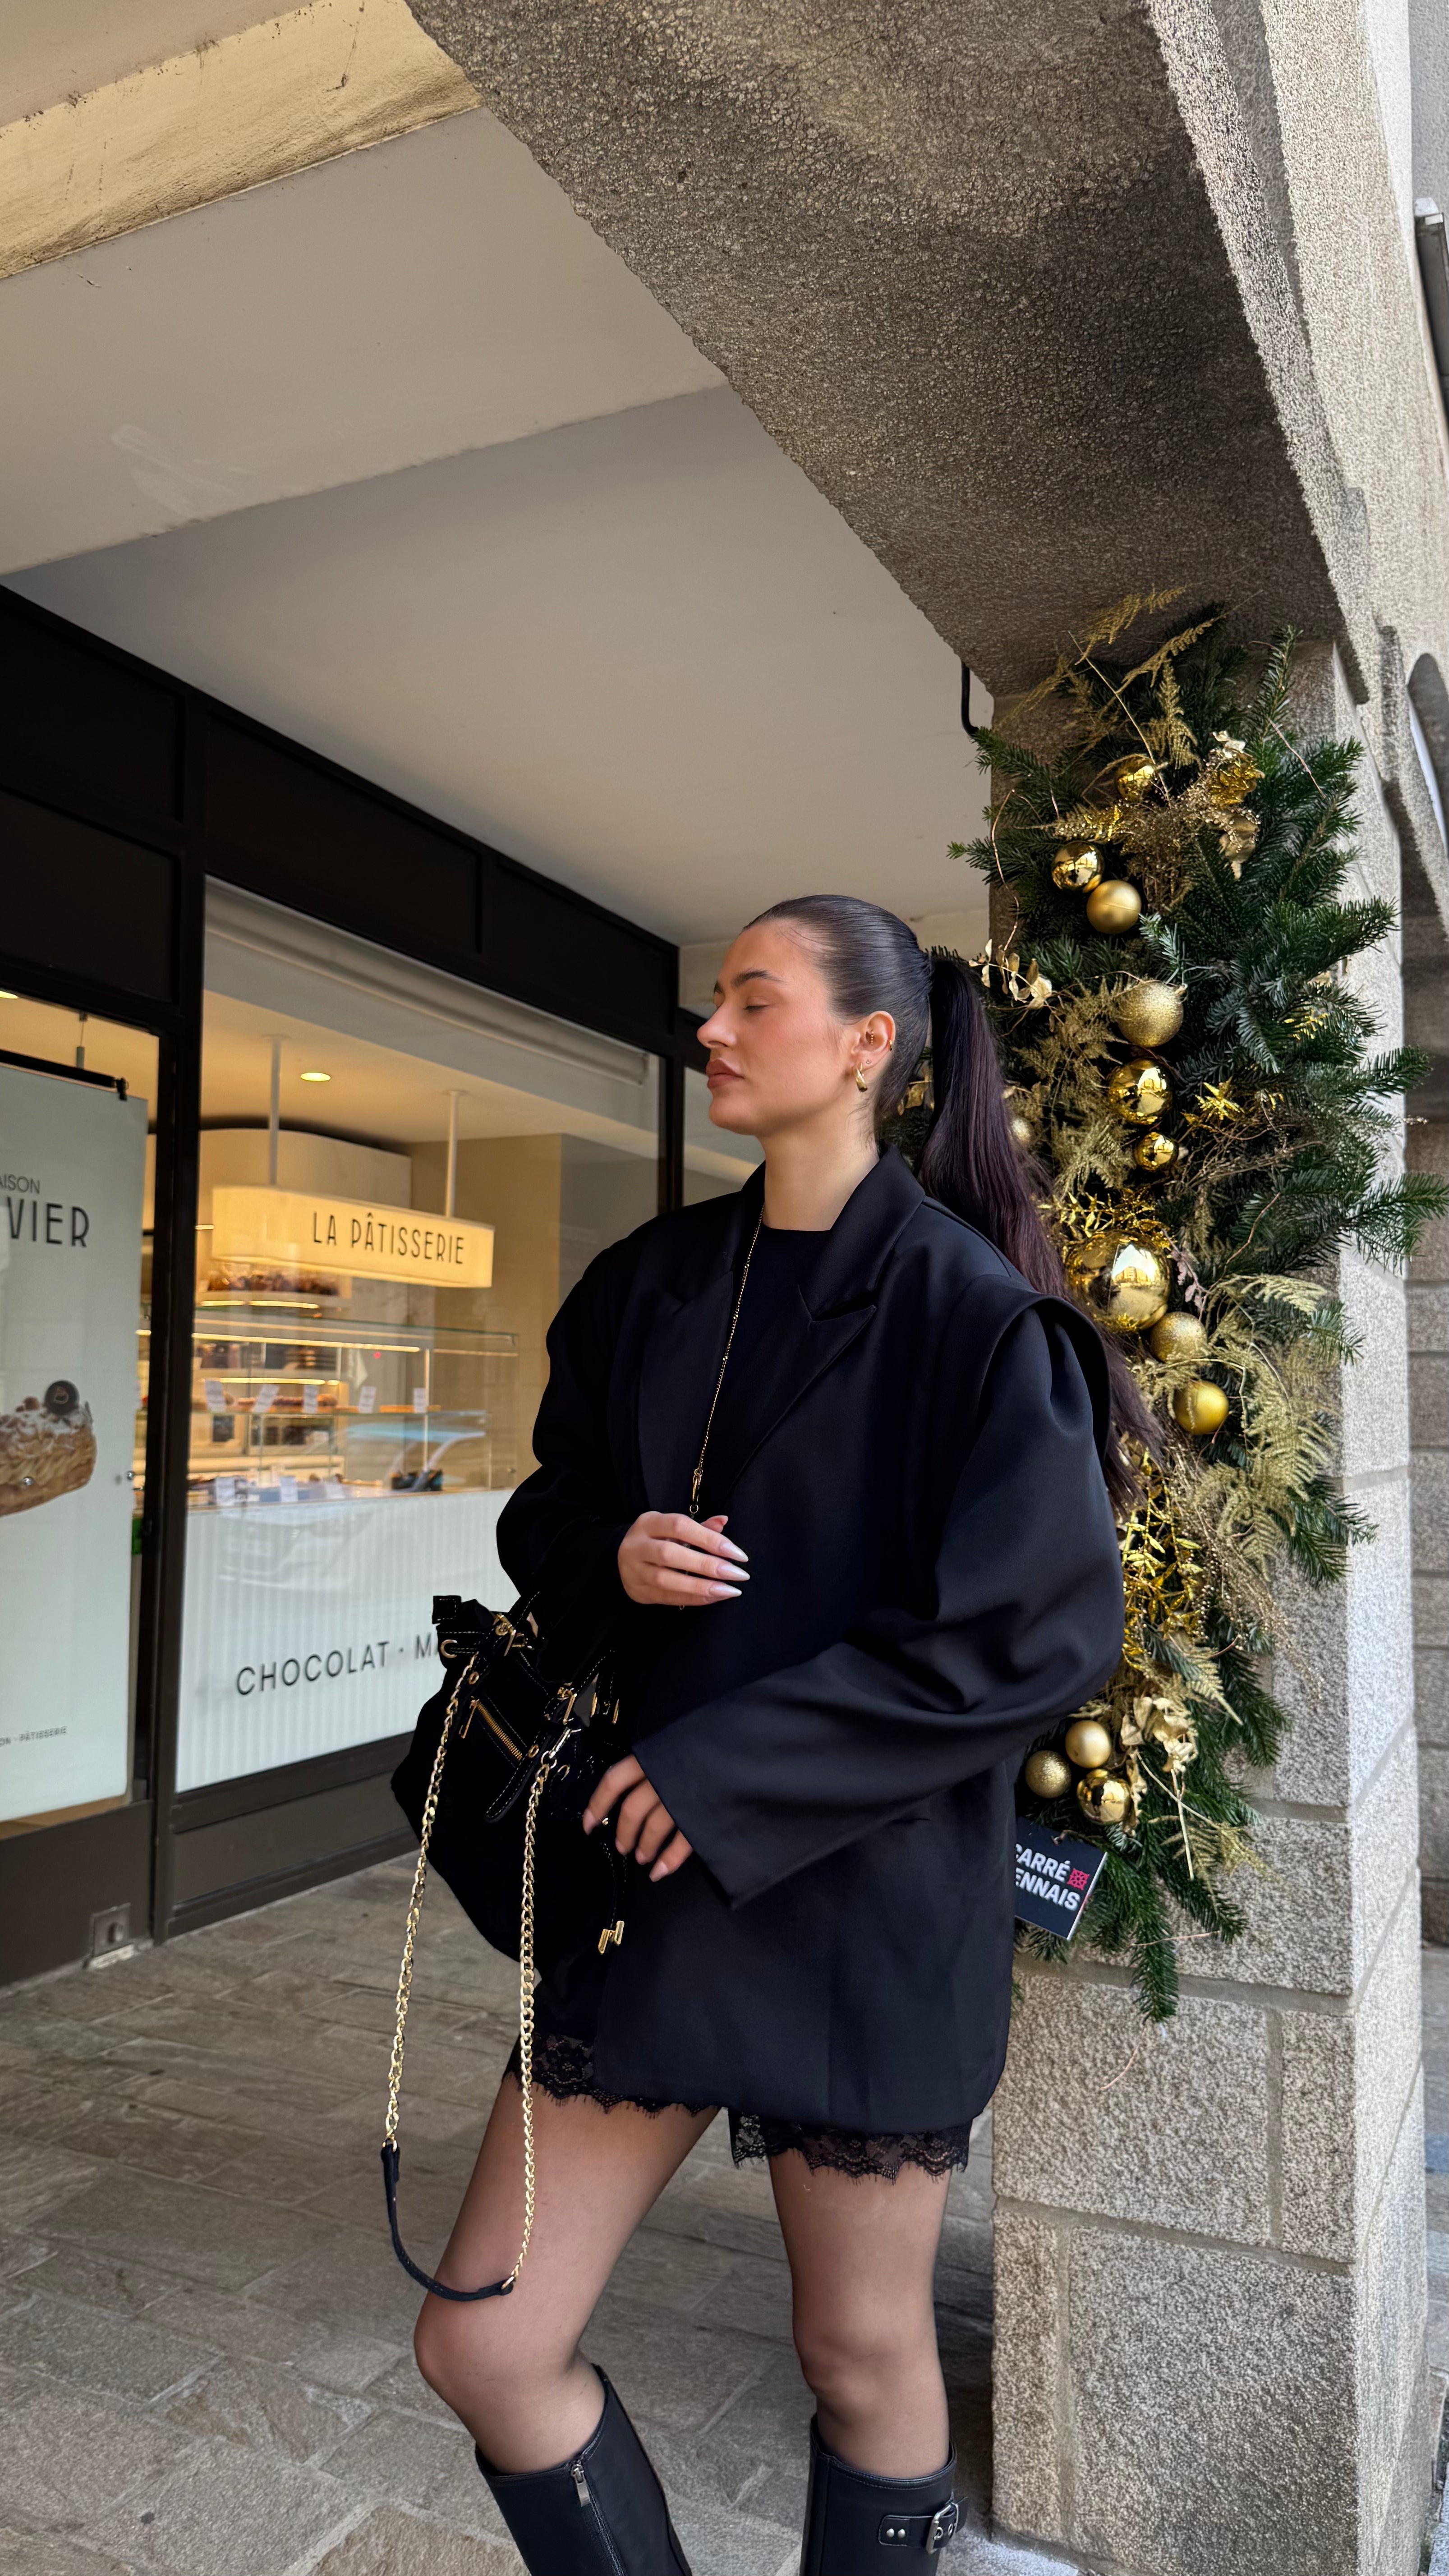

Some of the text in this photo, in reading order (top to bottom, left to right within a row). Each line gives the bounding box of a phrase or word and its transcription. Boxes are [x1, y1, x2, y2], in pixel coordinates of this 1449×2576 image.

[7, 1196, 90, 1248] VIER
[313, 1211, 465, 1265] LA PÂTISSERIE
[236, 1632, 439, 1696] CHOCOLAT M
